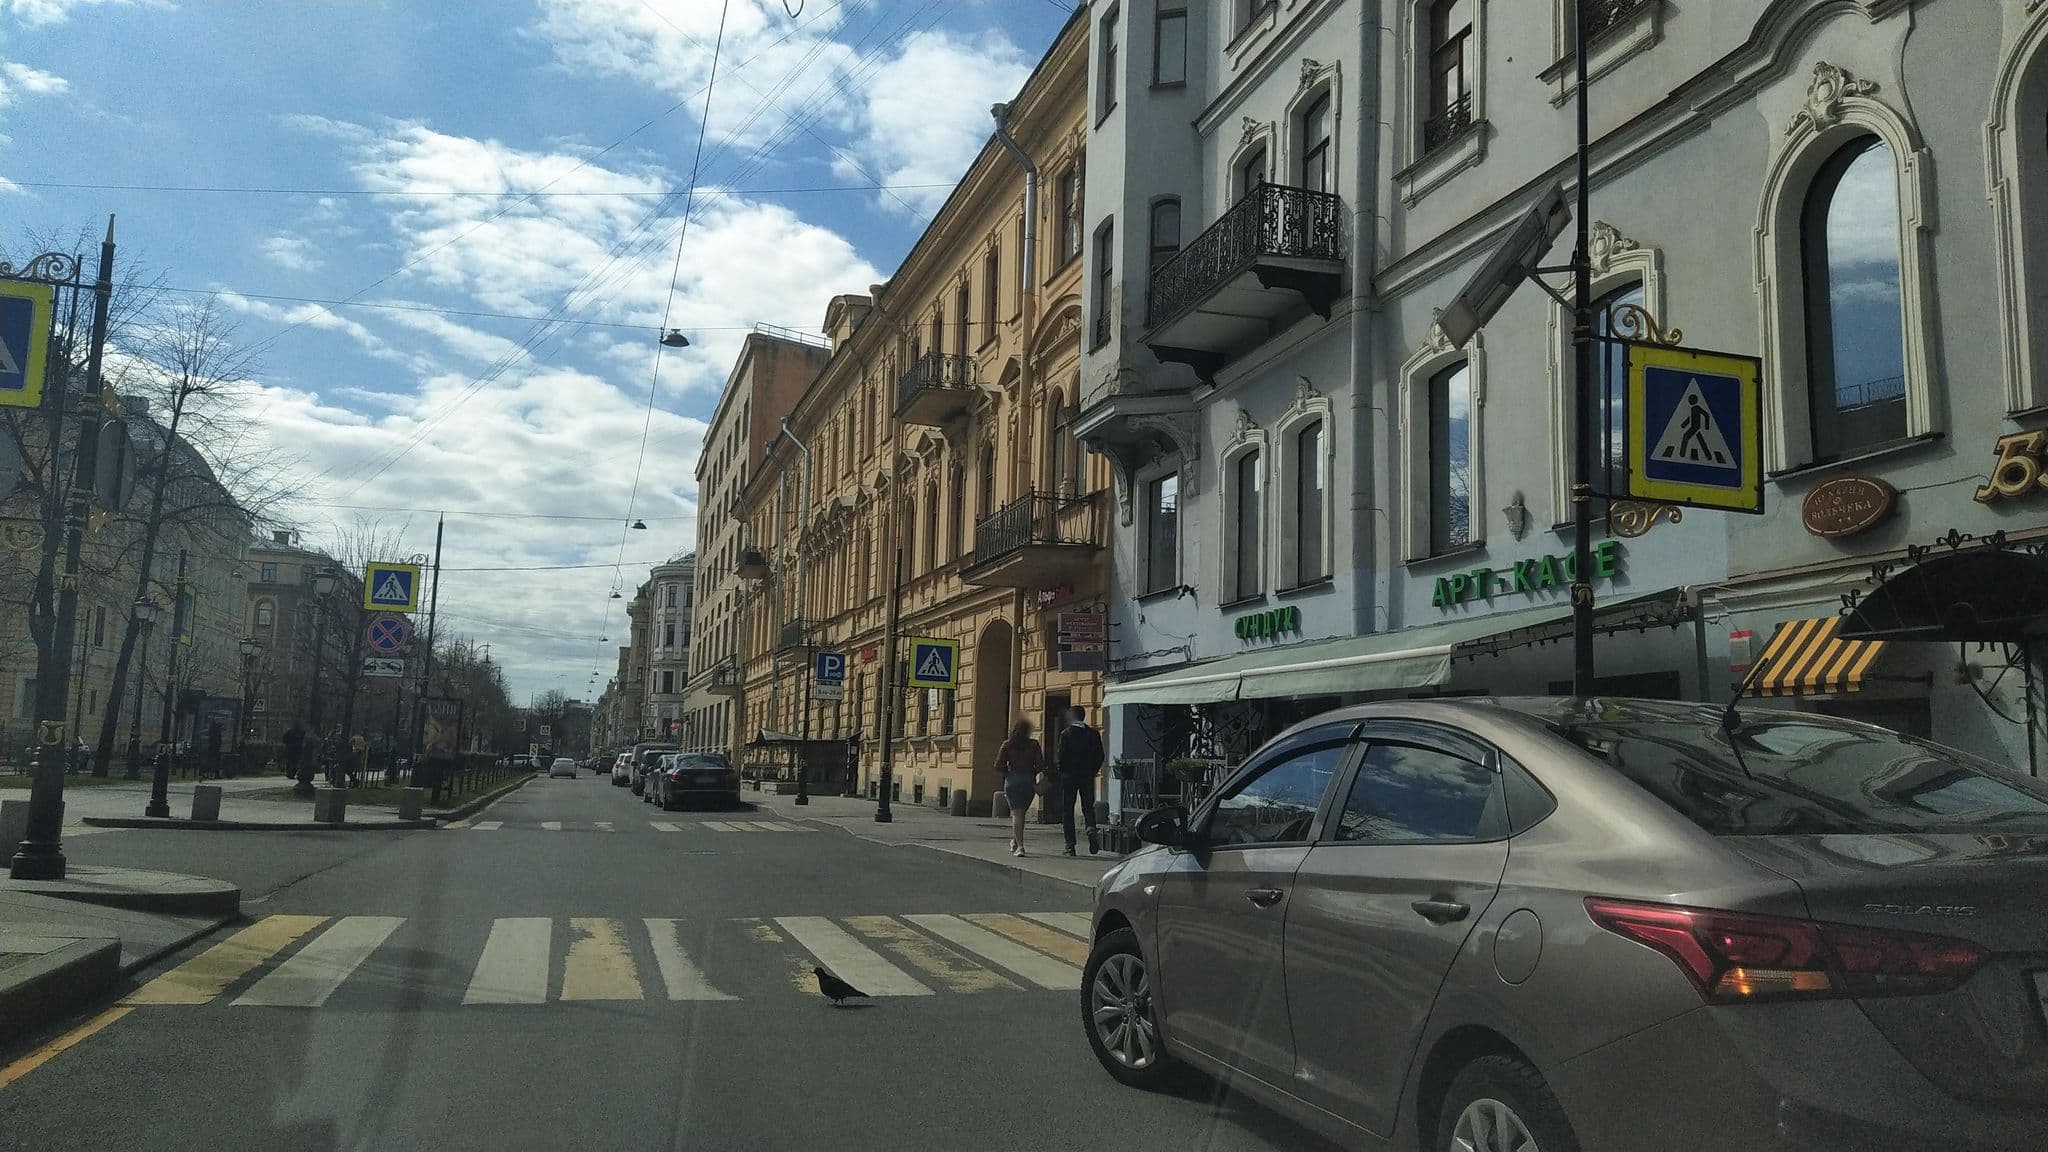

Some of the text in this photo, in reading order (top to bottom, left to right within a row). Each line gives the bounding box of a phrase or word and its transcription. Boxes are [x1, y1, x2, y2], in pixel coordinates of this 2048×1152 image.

[1974, 431, 2048, 502] Б
[1234, 605, 1298, 640] СУНДУК
[1863, 903, 1978, 918] SOLARIS
